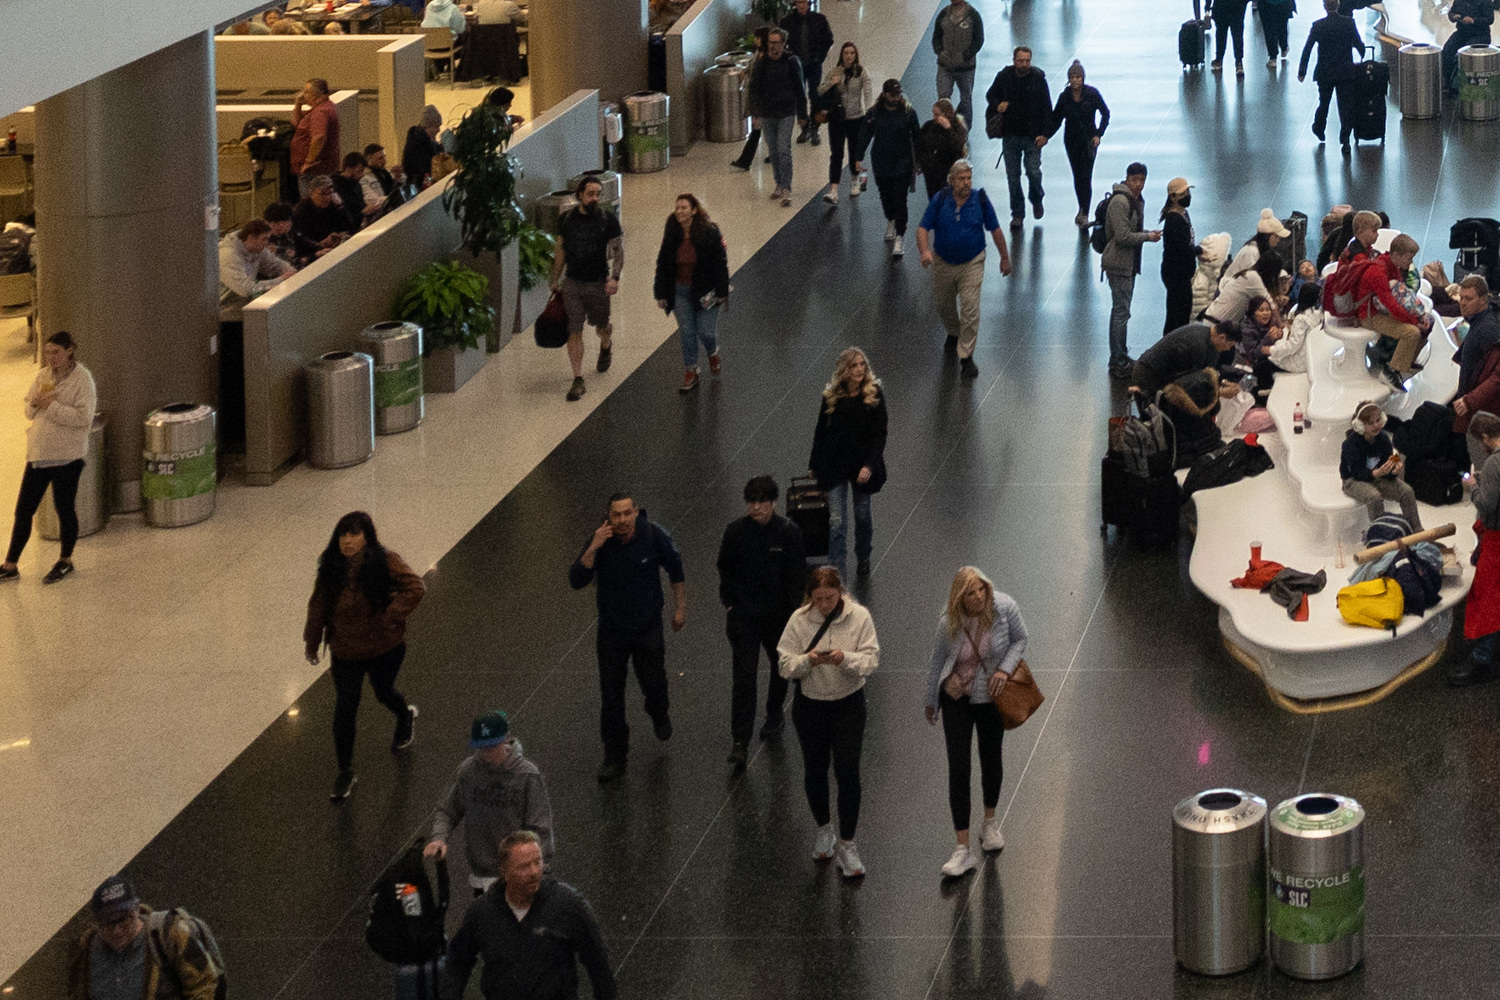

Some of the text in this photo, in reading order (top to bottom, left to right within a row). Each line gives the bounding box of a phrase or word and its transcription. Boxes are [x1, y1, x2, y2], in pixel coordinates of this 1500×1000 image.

[156, 446, 207, 462] RECYCLE
[157, 463, 175, 476] SLC
[1286, 871, 1351, 889] RECYCLE
[1288, 890, 1309, 909] SLC
